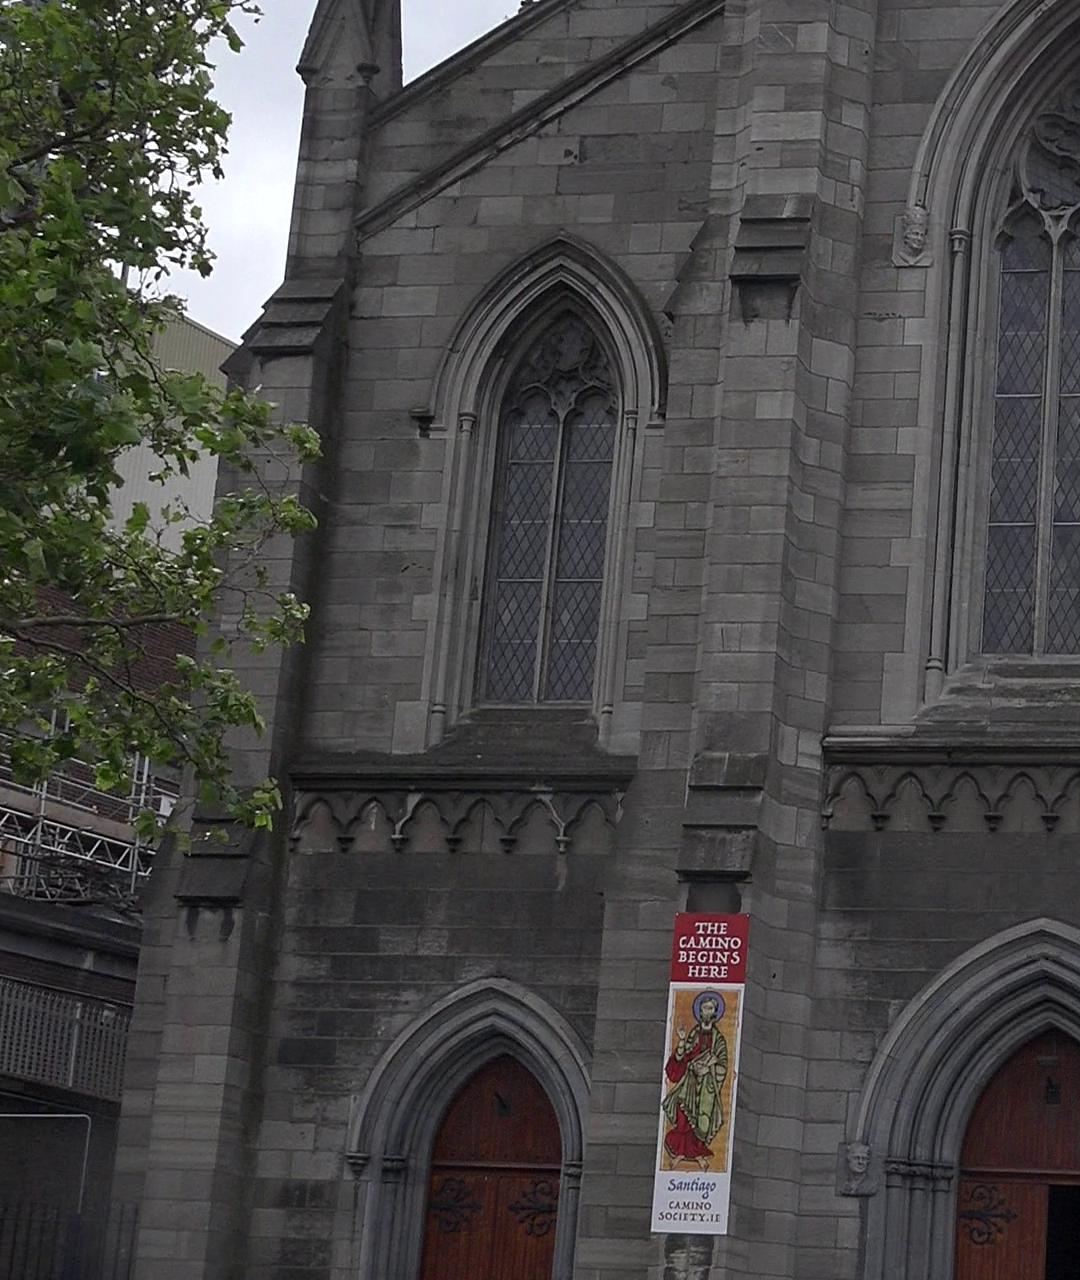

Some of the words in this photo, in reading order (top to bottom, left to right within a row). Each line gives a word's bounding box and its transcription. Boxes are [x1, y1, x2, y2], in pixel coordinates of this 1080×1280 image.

[695, 922, 728, 935] THE
[679, 936, 742, 950] CAMINO
[678, 950, 741, 965] BEGINS
[688, 965, 729, 979] HERE
[667, 1177, 717, 1200] Santiago
[668, 1200, 712, 1211] CAMINO
[658, 1211, 721, 1223] SOCIETY.IE
